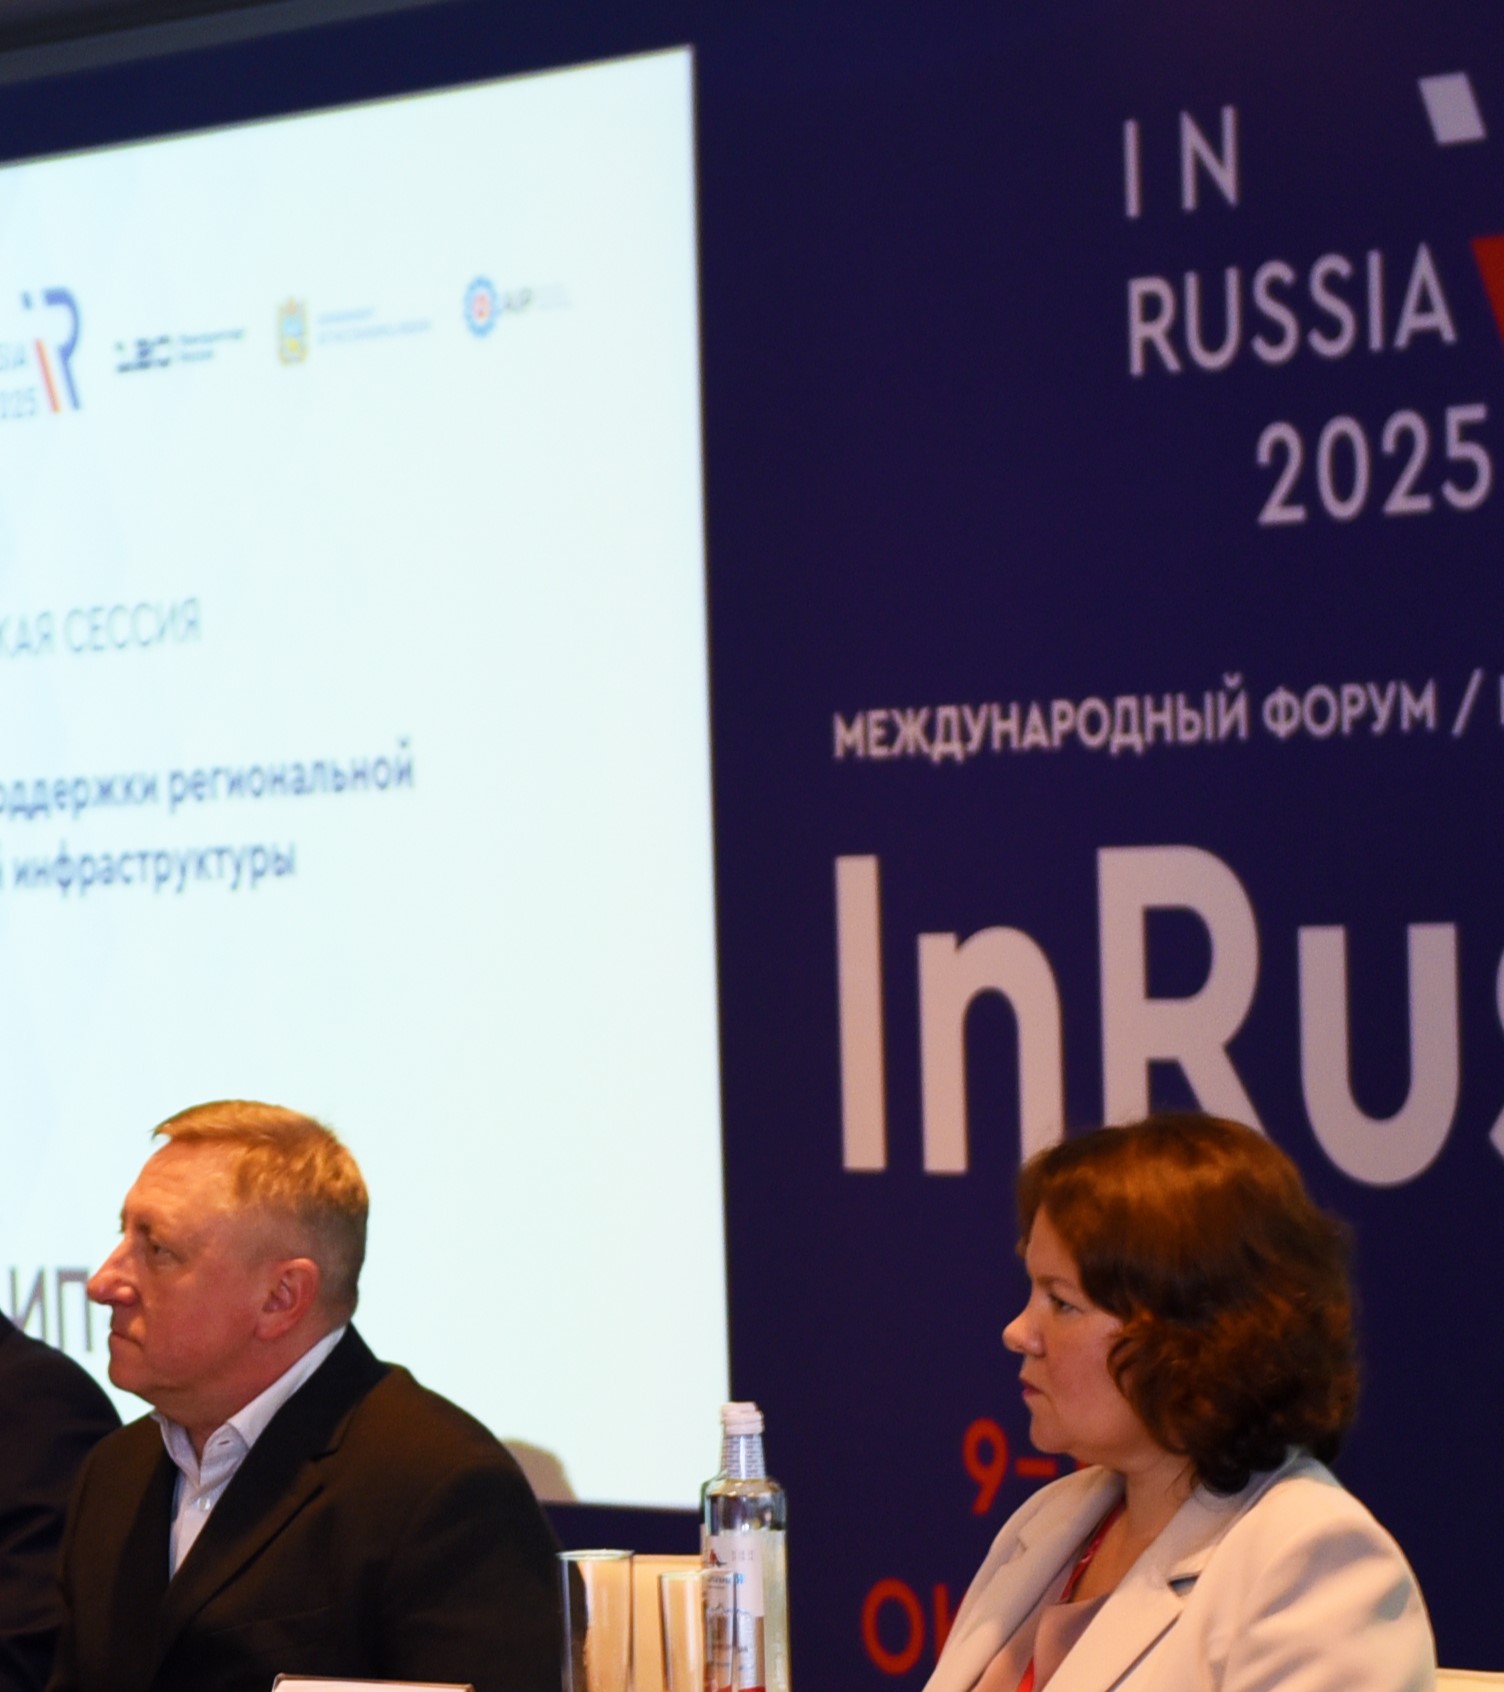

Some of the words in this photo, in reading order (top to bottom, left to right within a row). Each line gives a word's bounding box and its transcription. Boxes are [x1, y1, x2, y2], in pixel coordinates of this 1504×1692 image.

[1123, 107, 1239, 218] IN
[1127, 242, 1457, 377] RUSSIA
[1255, 404, 1492, 525] 2025
[65, 597, 202, 655] СЕССИЯ
[833, 673, 1250, 763] МЕЖДУНАРОДНЫЙ
[1262, 680, 1437, 744] ФОРУМ
[168, 738, 416, 815] региональной
[14, 838, 297, 898] инфраструктуры
